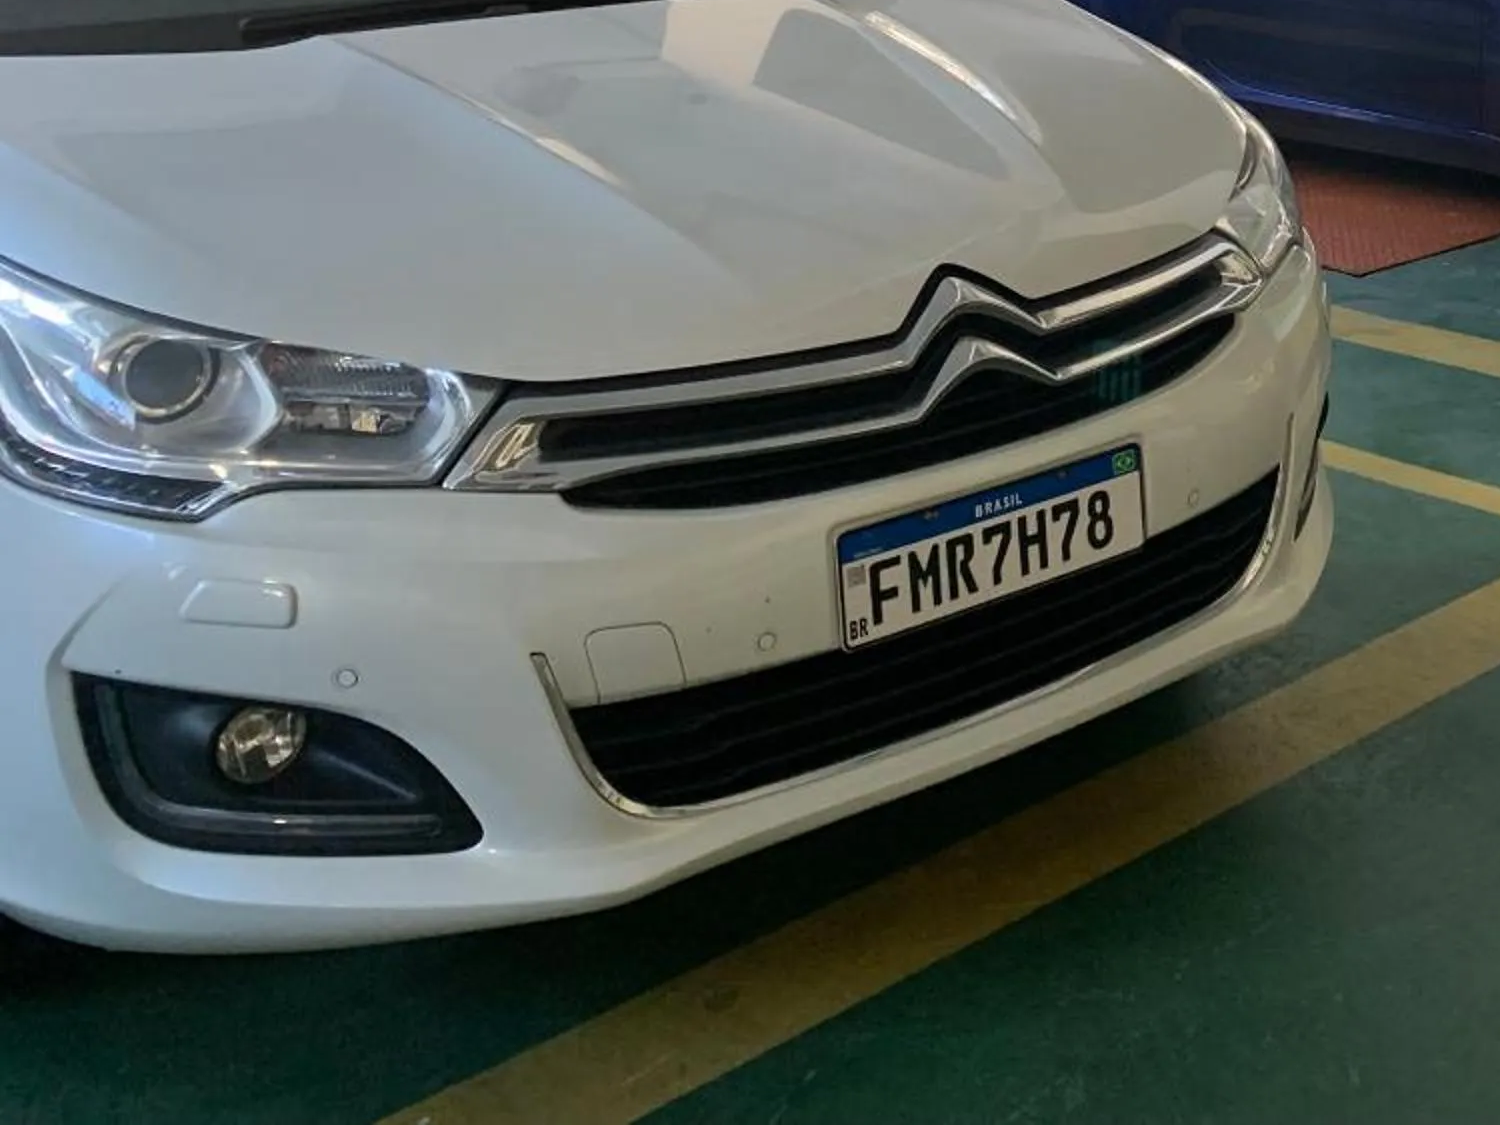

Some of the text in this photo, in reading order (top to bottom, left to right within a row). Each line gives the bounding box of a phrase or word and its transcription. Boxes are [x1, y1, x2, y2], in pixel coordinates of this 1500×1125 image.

[975, 492, 1023, 518] BRASIL
[869, 490, 1113, 625] FMR7H78
[850, 618, 868, 640] BR
